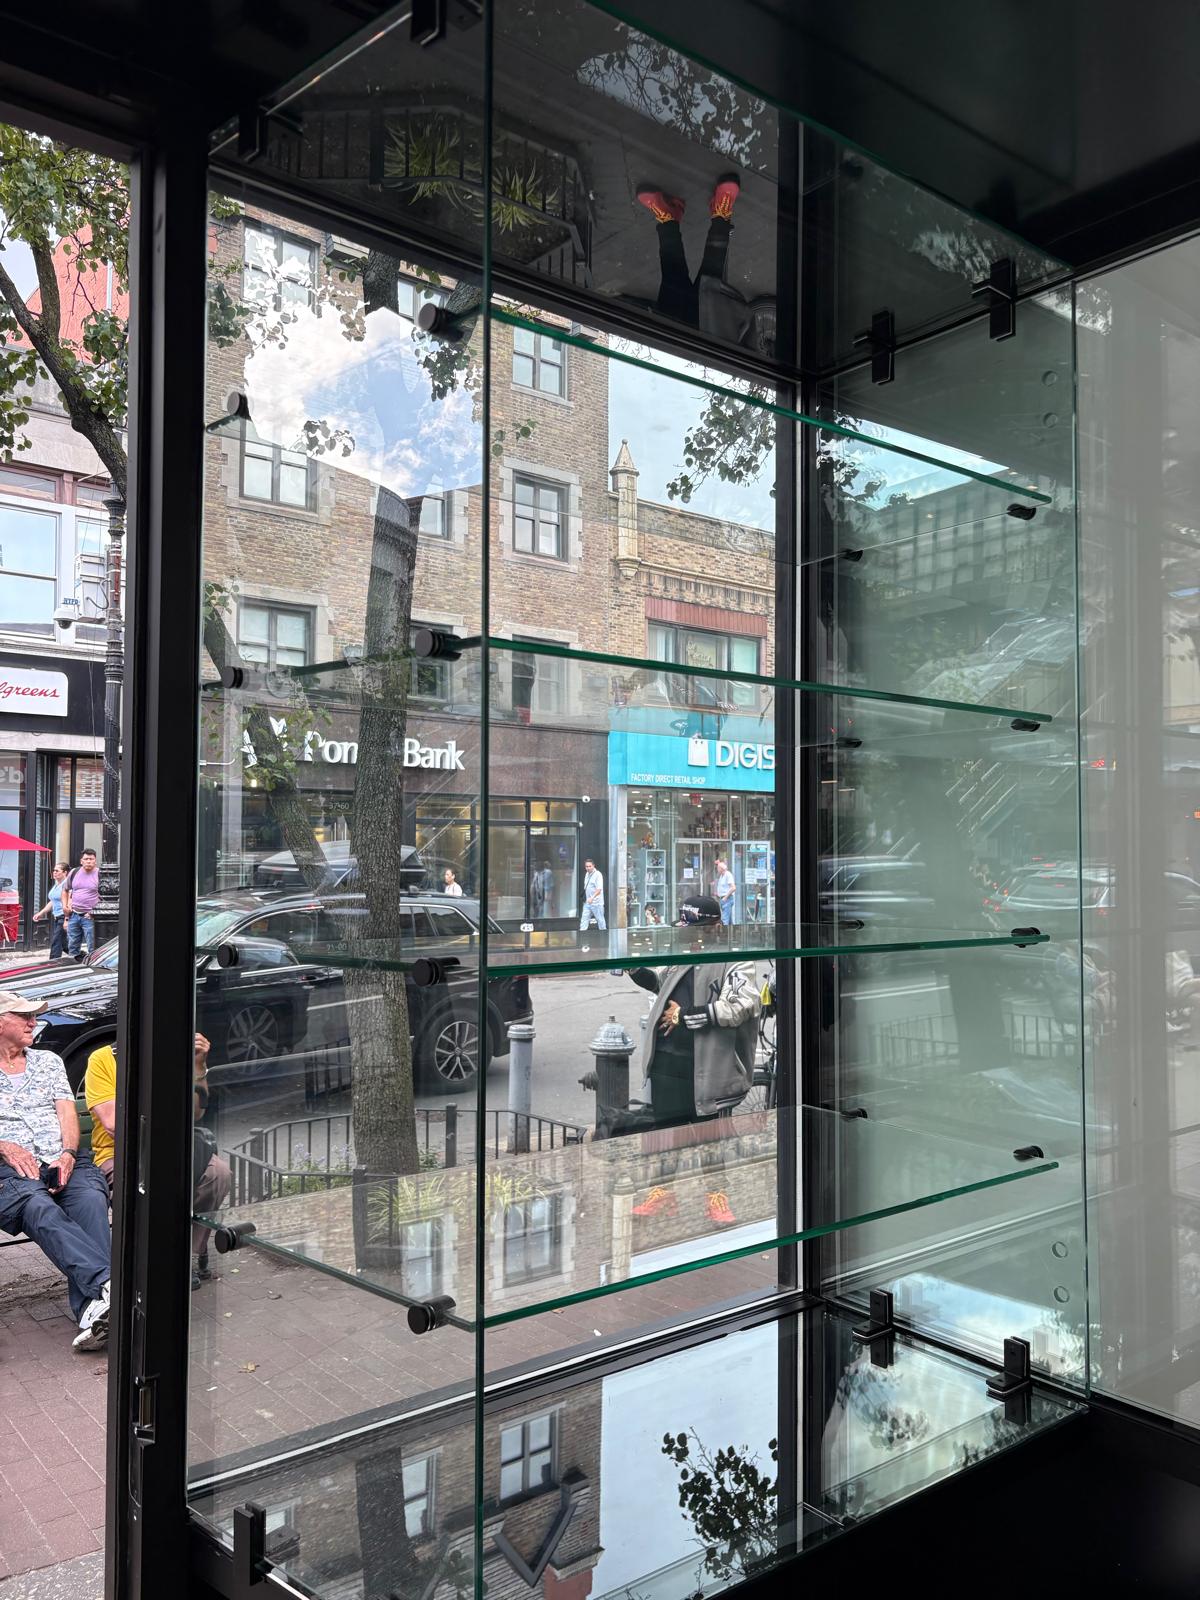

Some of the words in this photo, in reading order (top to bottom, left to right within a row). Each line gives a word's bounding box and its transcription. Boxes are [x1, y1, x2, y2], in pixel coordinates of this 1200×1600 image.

[303, 730, 358, 764] Pon
[403, 737, 465, 770] Bank
[631, 773, 654, 783] FACTORY
[655, 774, 674, 784] DIRECT
[674, 775, 691, 785] RETAIL
[692, 776, 706, 785] SHOP
